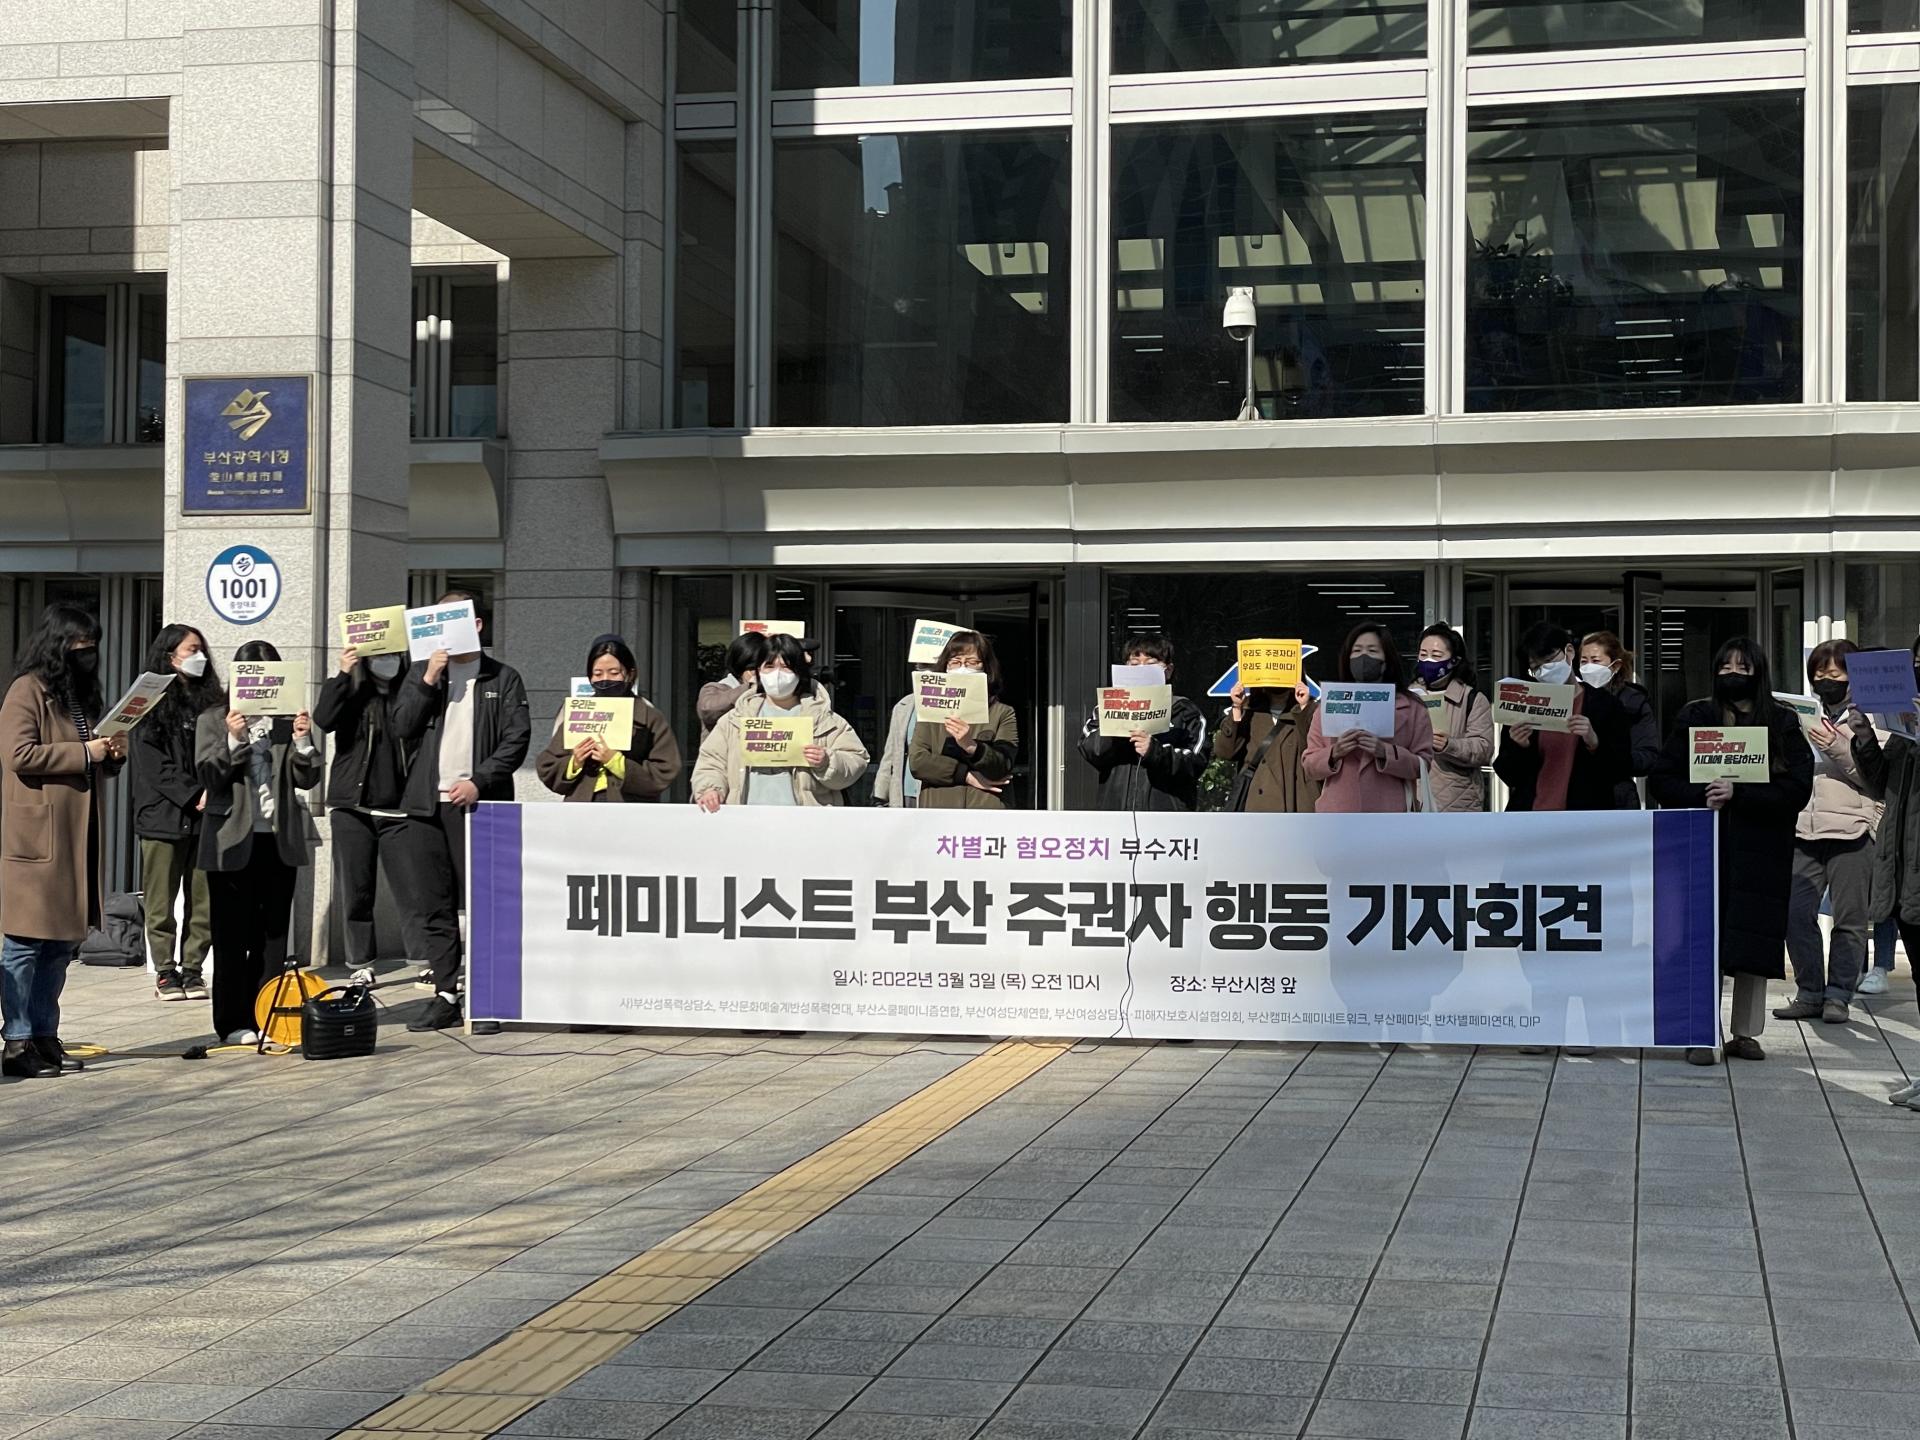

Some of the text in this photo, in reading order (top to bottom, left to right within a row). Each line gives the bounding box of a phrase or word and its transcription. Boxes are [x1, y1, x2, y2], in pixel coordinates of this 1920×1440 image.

[220, 578, 267, 599] 1001
[1243, 649, 1296, 658] 우리도 주권자다!
[236, 665, 265, 675] 우리는
[1243, 662, 1296, 671] 우리도 시민이다!
[920, 675, 947, 686] 우리는
[570, 700, 596, 709] 우리는
[1499, 702, 1568, 718] 시대에 응답하라!
[1104, 709, 1167, 721] 시대에 응답하라!
[745, 719, 773, 729] 우리는
[1694, 754, 1765, 765] 시대에 응답하라!
[937, 835, 1199, 861] 차별과 혐오정치 부수자!
[567, 874, 1602, 952] 페미니스트 부산 주권자 행동 기자회견
[832, 968, 1100, 991] 일시: 2022년 3월 3일 (목) 오전 10시
[1170, 975, 1297, 995] 장소: 부산시청 앞
